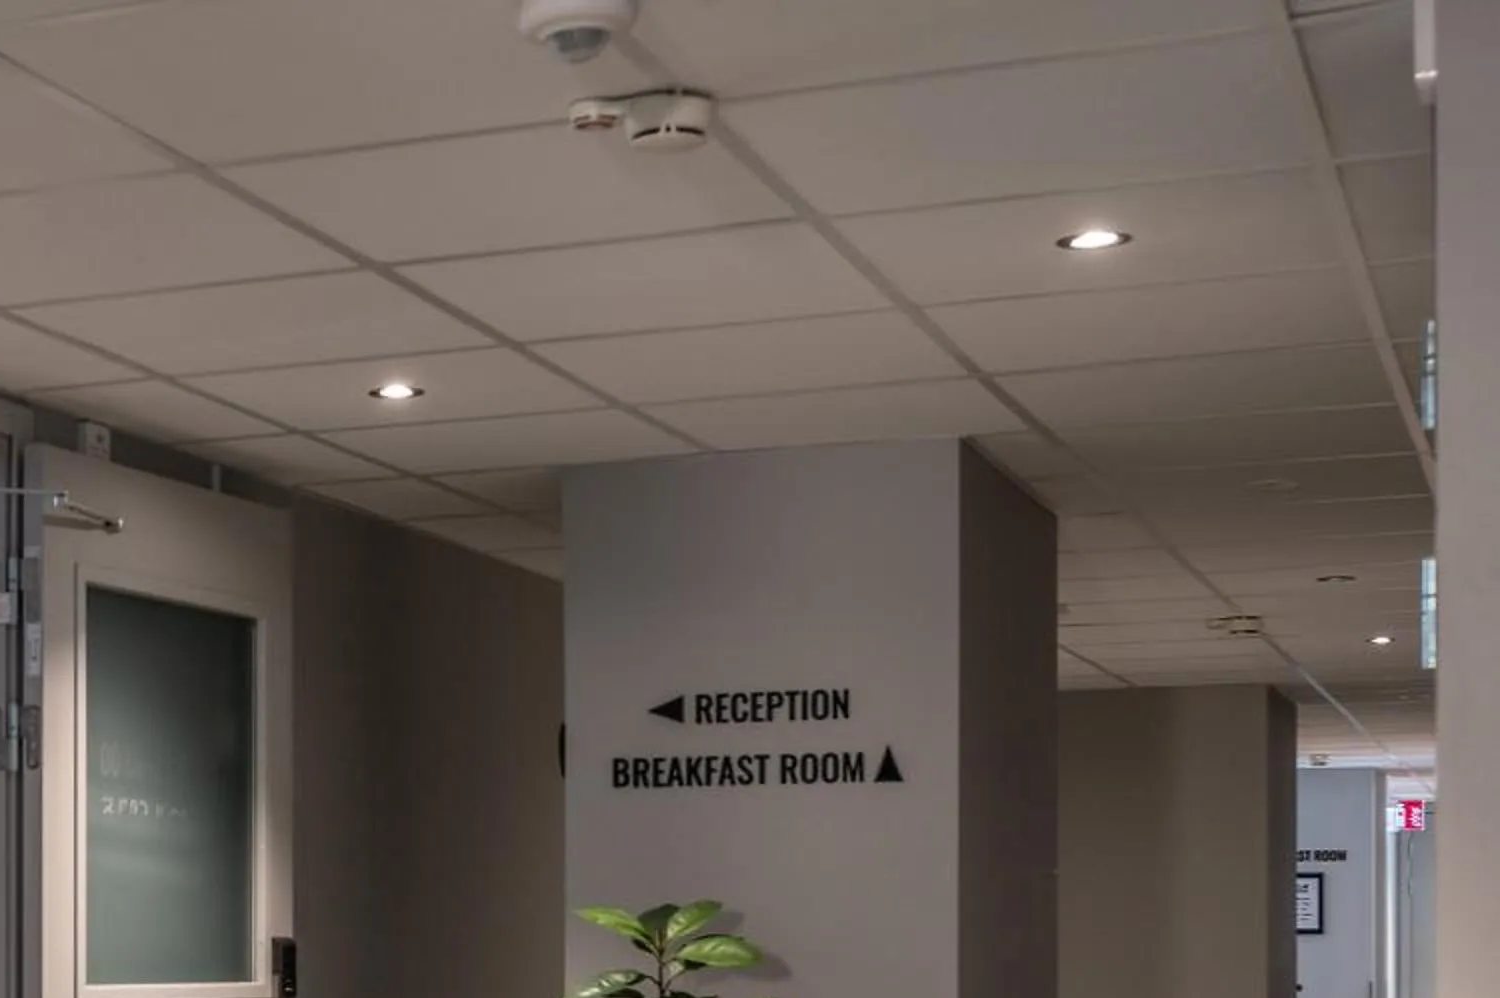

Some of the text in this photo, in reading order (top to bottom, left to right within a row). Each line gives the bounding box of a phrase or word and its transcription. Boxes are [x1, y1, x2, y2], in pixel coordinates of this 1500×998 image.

[694, 688, 850, 725] RECEPTION
[611, 751, 865, 789] BREAKFAST ROOM
[1296, 850, 1347, 861] ST ROOM
